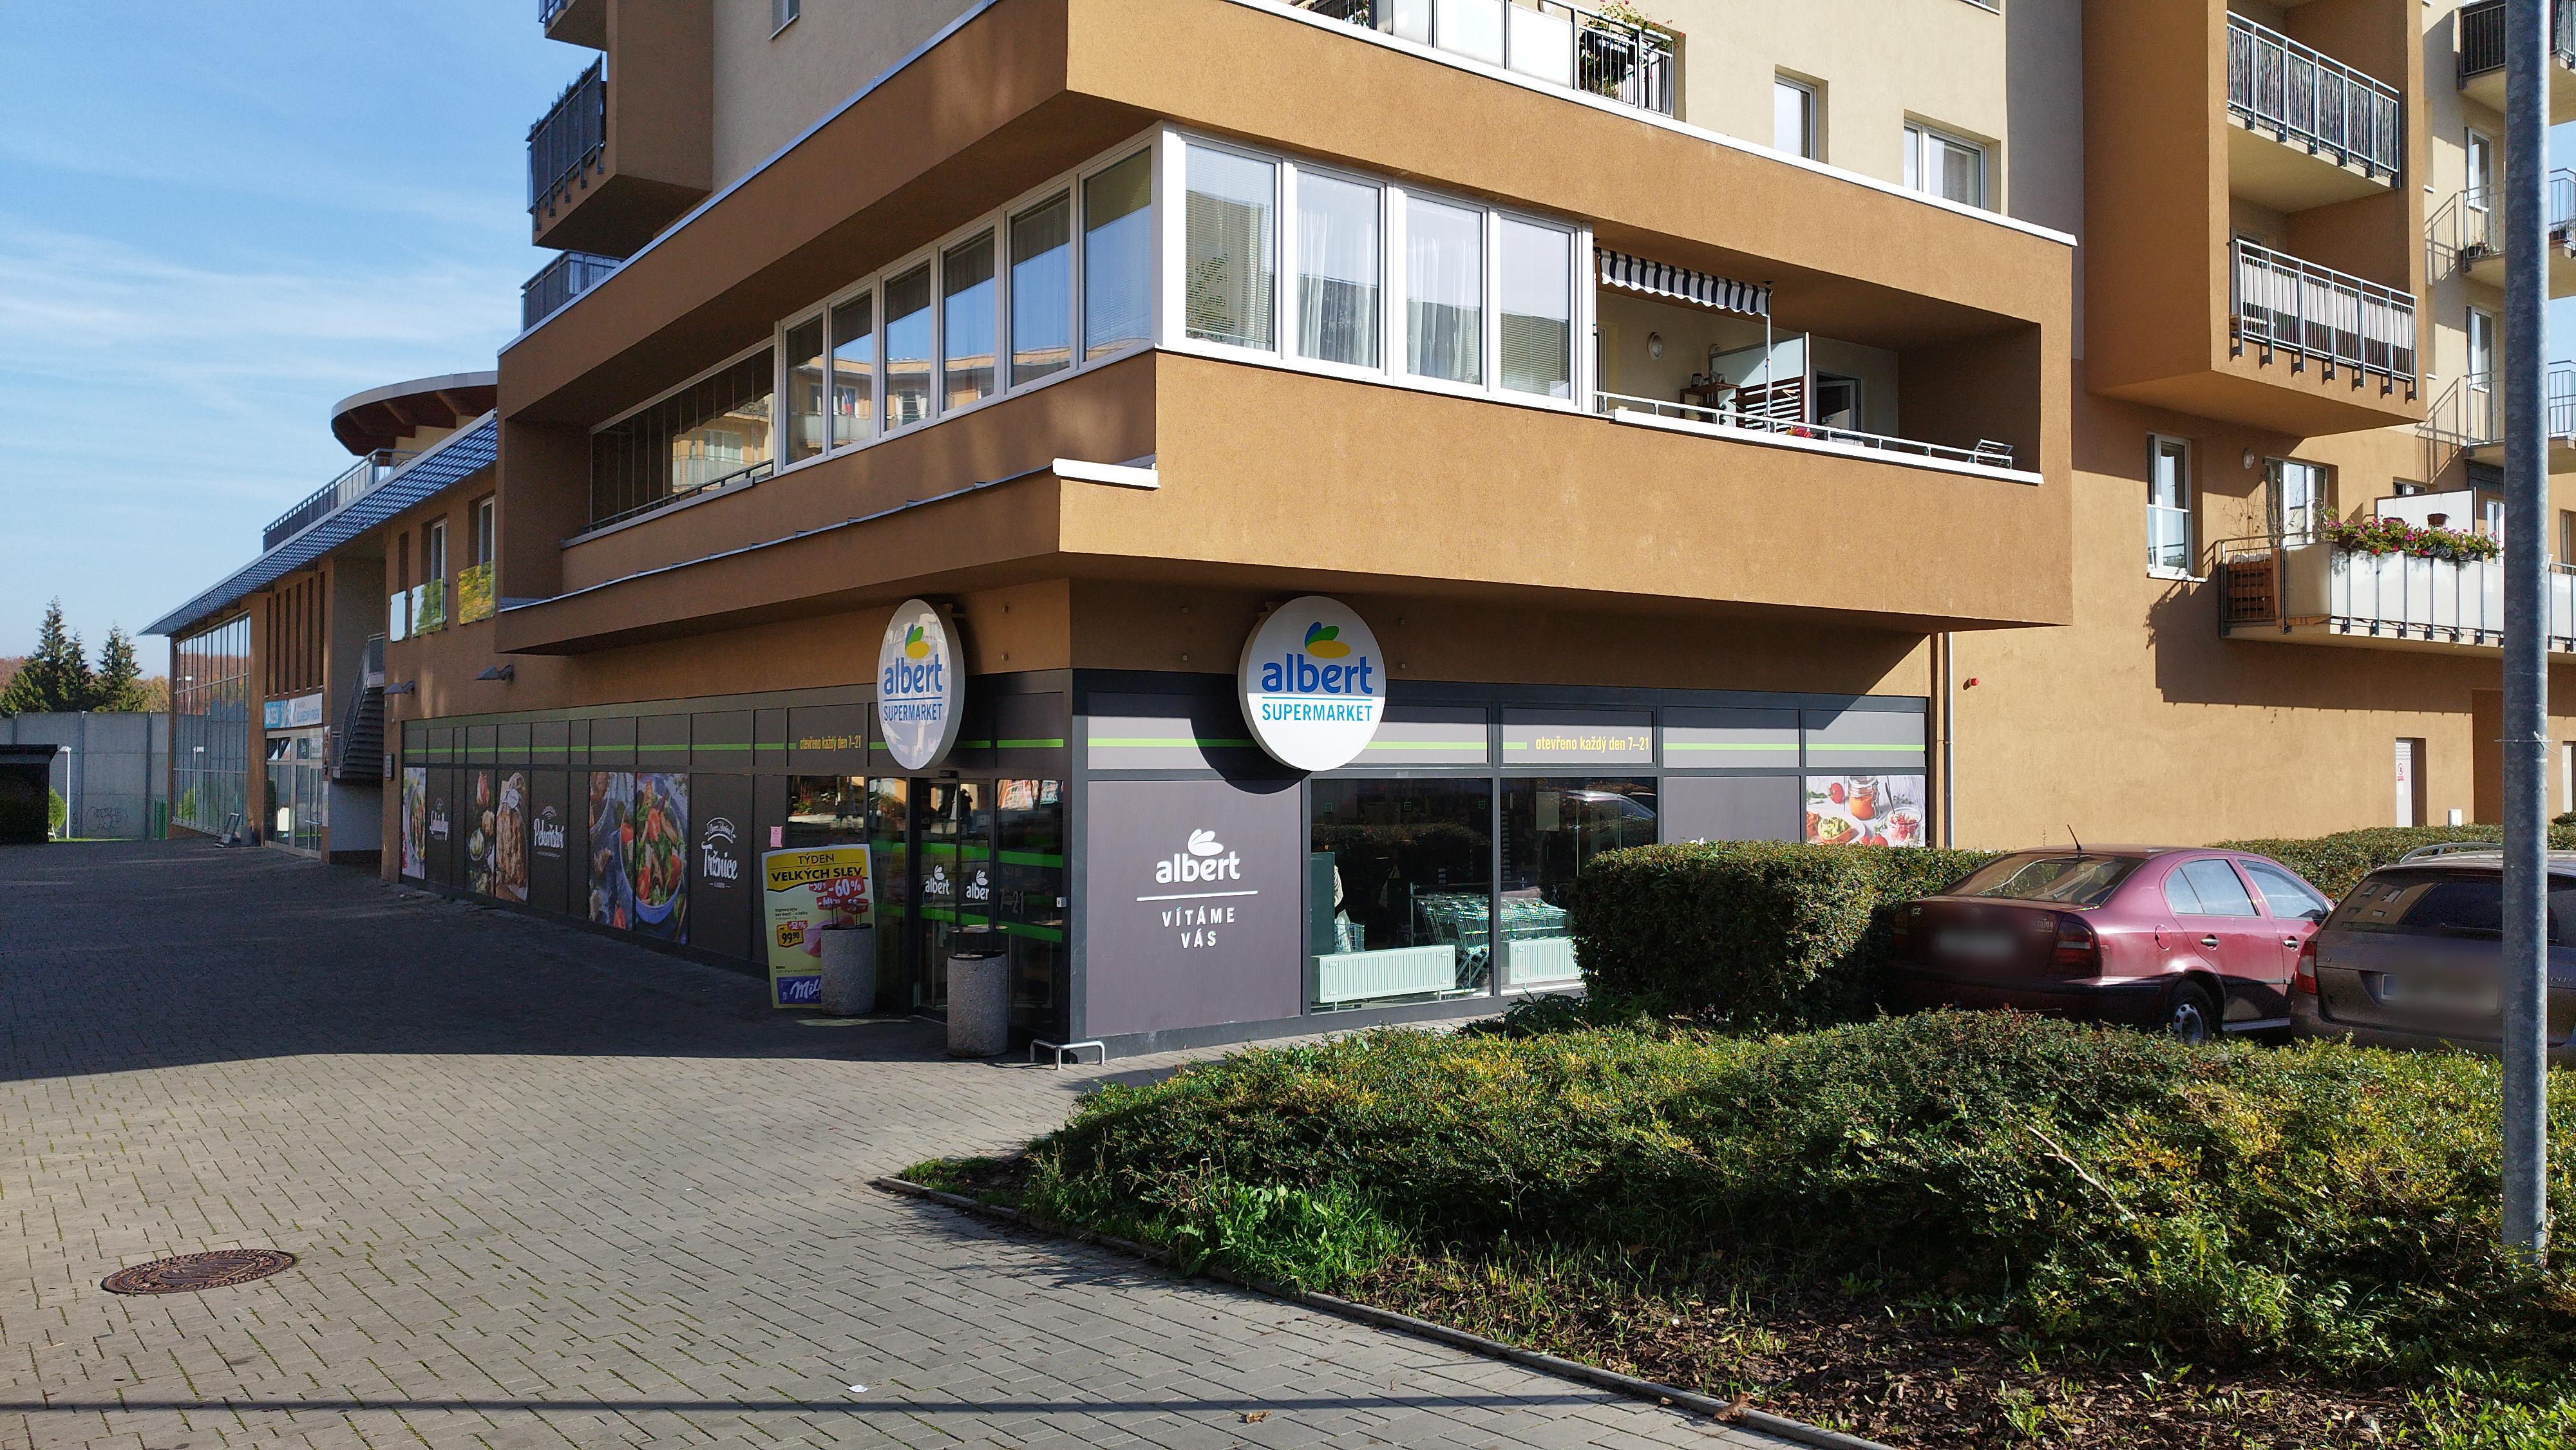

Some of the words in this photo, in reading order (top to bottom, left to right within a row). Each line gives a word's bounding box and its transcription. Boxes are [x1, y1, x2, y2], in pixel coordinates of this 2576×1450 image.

[884, 654, 942, 695] albert
[1262, 653, 1373, 695] albert
[884, 703, 942, 722] SUPERMARKET
[1262, 703, 1373, 722] SUPERMARKET
[1535, 735, 1577, 751] otevřeno
[1580, 735, 1607, 753] každý
[1609, 736, 1625, 751] den
[798, 852, 835, 865] TÝDEN
[1155, 851, 1240, 884] albert
[771, 867, 829, 882] VELKÝCH
[833, 866, 863, 878] SLEV
[925, 876, 950, 896] albert
[966, 882, 990, 901] alber
[1161, 905, 1236, 928] VÍTÁME
[1180, 929, 1217, 948] VÁS
[790, 979, 821, 1000] Mil
